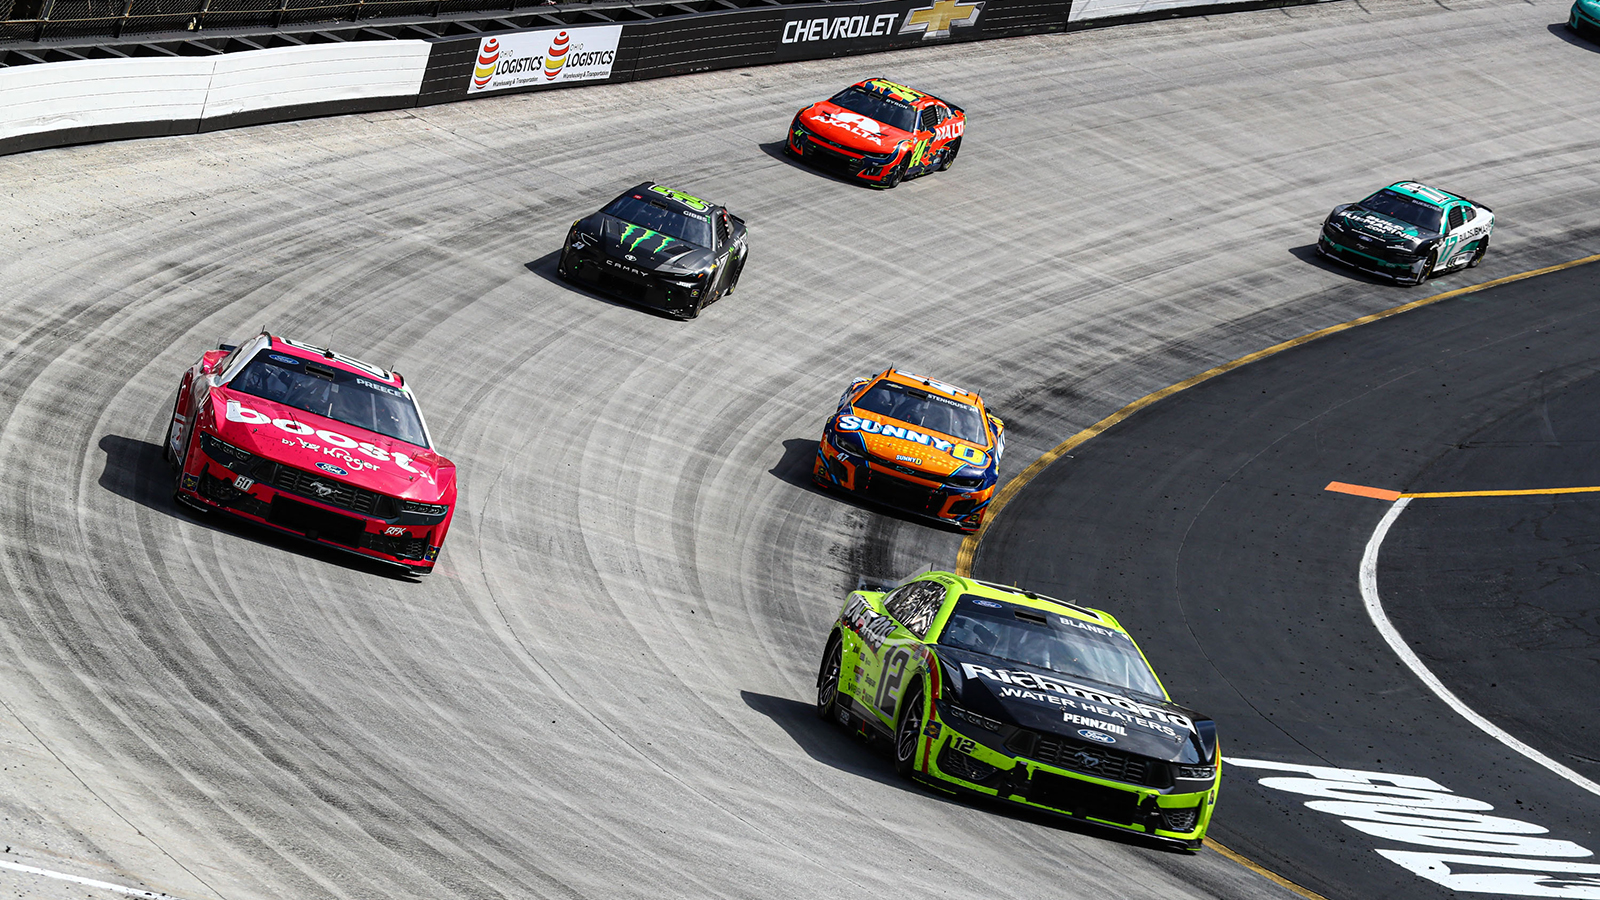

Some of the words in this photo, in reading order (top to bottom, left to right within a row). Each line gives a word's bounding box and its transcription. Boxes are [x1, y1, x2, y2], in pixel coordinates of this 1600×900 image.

[782, 13, 899, 44] CHEVROLET
[496, 56, 543, 75] LOGISTICS
[566, 50, 614, 68] LOGISTICS
[492, 78, 513, 86] Warehousing
[886, 99, 908, 109] BYRON
[810, 115, 881, 146] AXALTA
[683, 211, 707, 222] GIBBS
[1366, 215, 1405, 231] BUILD
[606, 260, 649, 277] CAMRY
[356, 378, 402, 398] PREECE
[928, 394, 967, 410] STENHOUSE
[226, 399, 420, 474] boost
[281, 438, 296, 446] by
[323, 447, 381, 472] Kroger
[836, 453, 849, 462] 47
[896, 455, 922, 465] SUNNYD
[321, 464, 343, 475] Ford
[235, 475, 252, 491] 60
[1059, 616, 1114, 638] BLANEY
[874, 643, 910, 720] 12
[960, 662, 1198, 735] Richmond
[1002, 686, 1076, 708] WATER
[1081, 702, 1177, 737] HEATERS
[1063, 712, 1128, 736] PENNZOIL
[954, 736, 976, 754] 12
[1085, 731, 1108, 742] Ford
